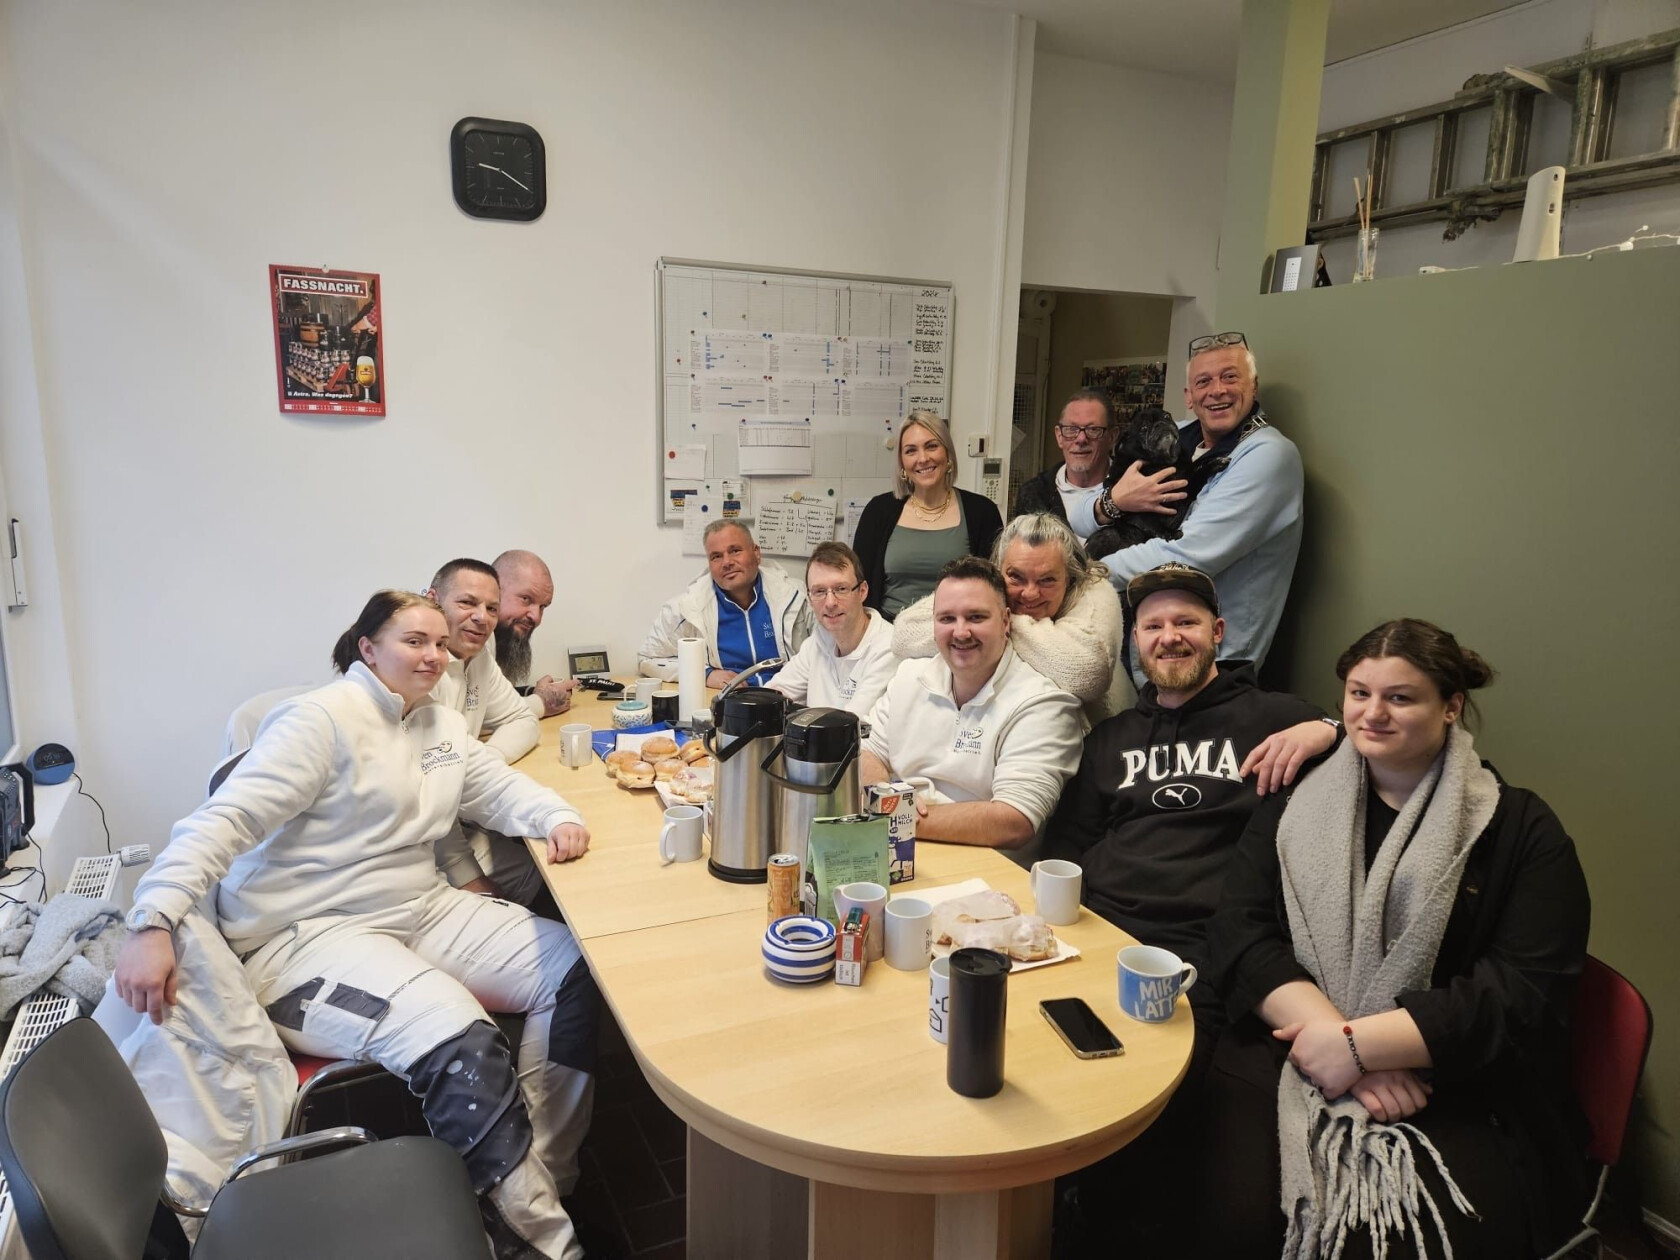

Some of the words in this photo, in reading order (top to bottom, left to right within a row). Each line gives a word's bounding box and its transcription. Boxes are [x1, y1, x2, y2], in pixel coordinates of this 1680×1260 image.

[283, 278, 364, 294] FASSNACHT.
[421, 752, 460, 771] Brockmann
[1118, 739, 1243, 789] PUMA
[890, 816, 898, 827] H
[1139, 977, 1173, 1003] MIR
